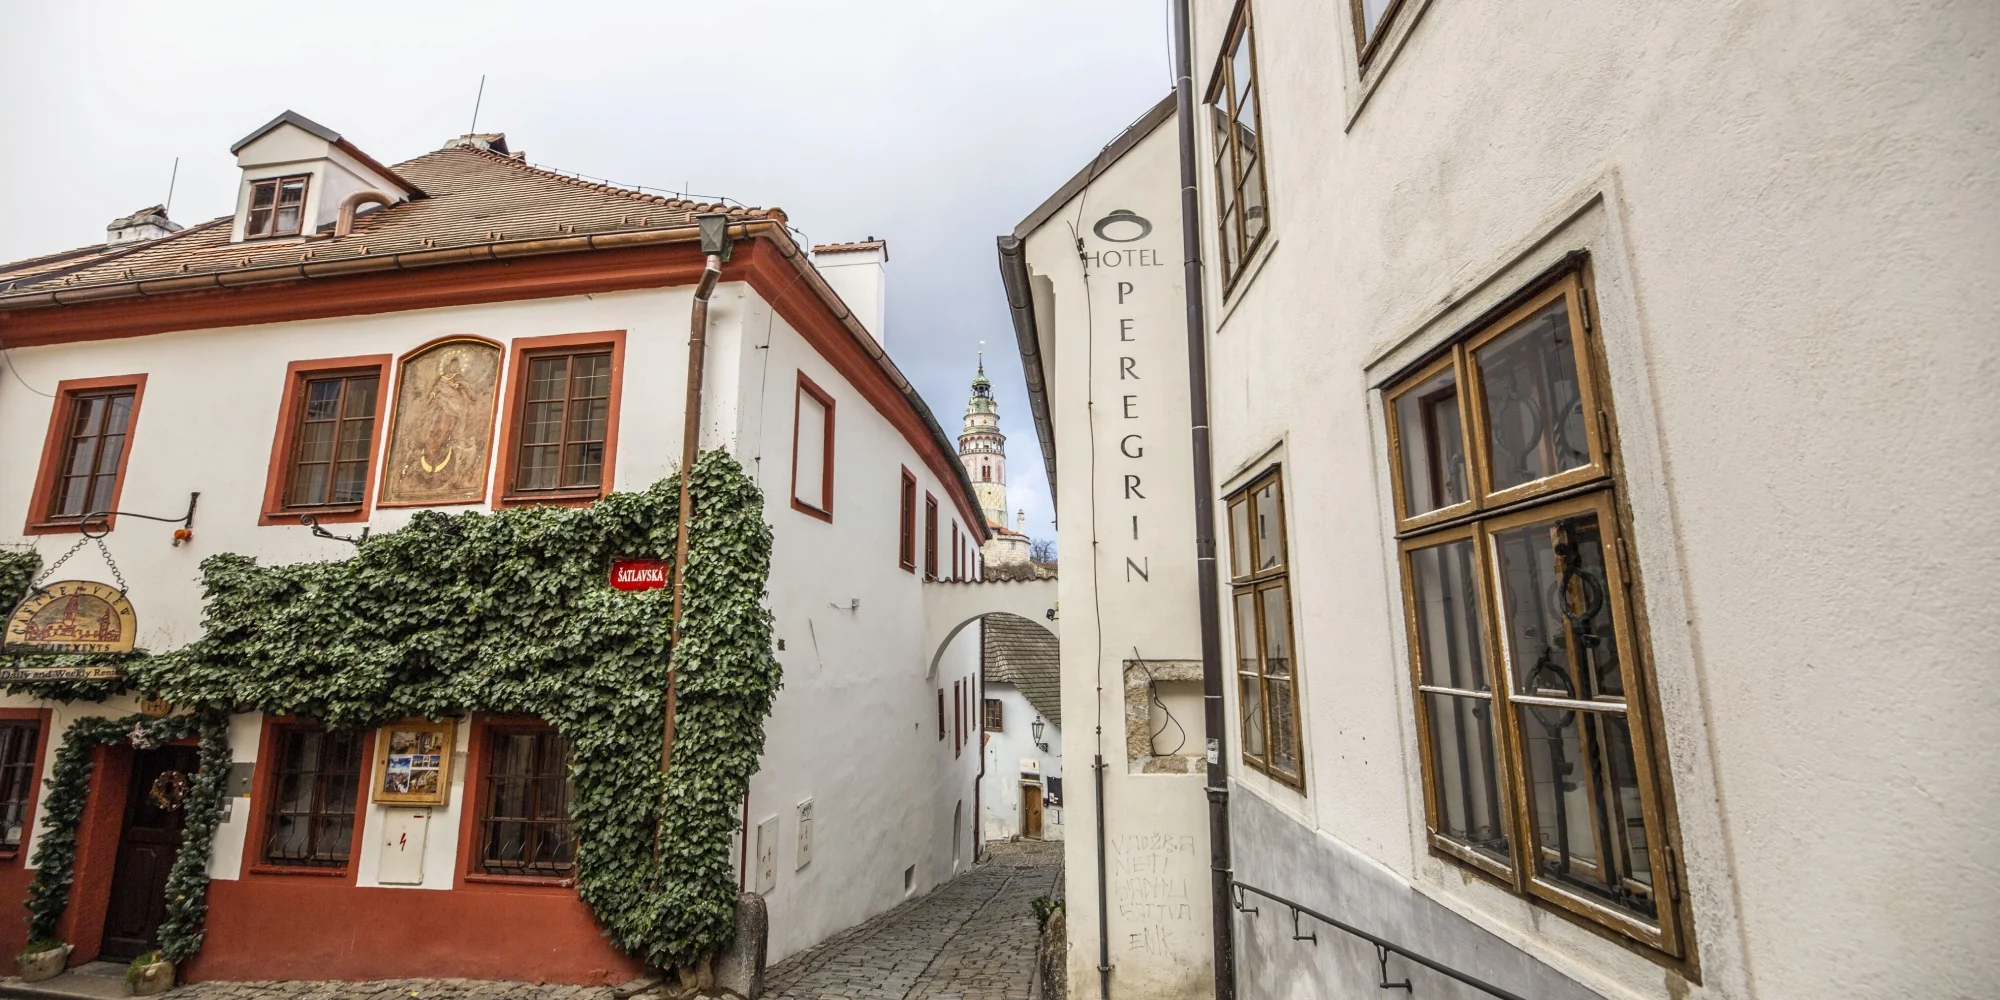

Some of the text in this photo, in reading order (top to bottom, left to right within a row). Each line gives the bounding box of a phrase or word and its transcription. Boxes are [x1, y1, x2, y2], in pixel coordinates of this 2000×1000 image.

[1086, 249, 1164, 268] HOTEL
[1117, 281, 1149, 583] PEREGRIN
[617, 566, 664, 582] ŠATLAVSKÁ
[93, 586, 131, 616] VIEW
[55, 667, 91, 679] Weekly
